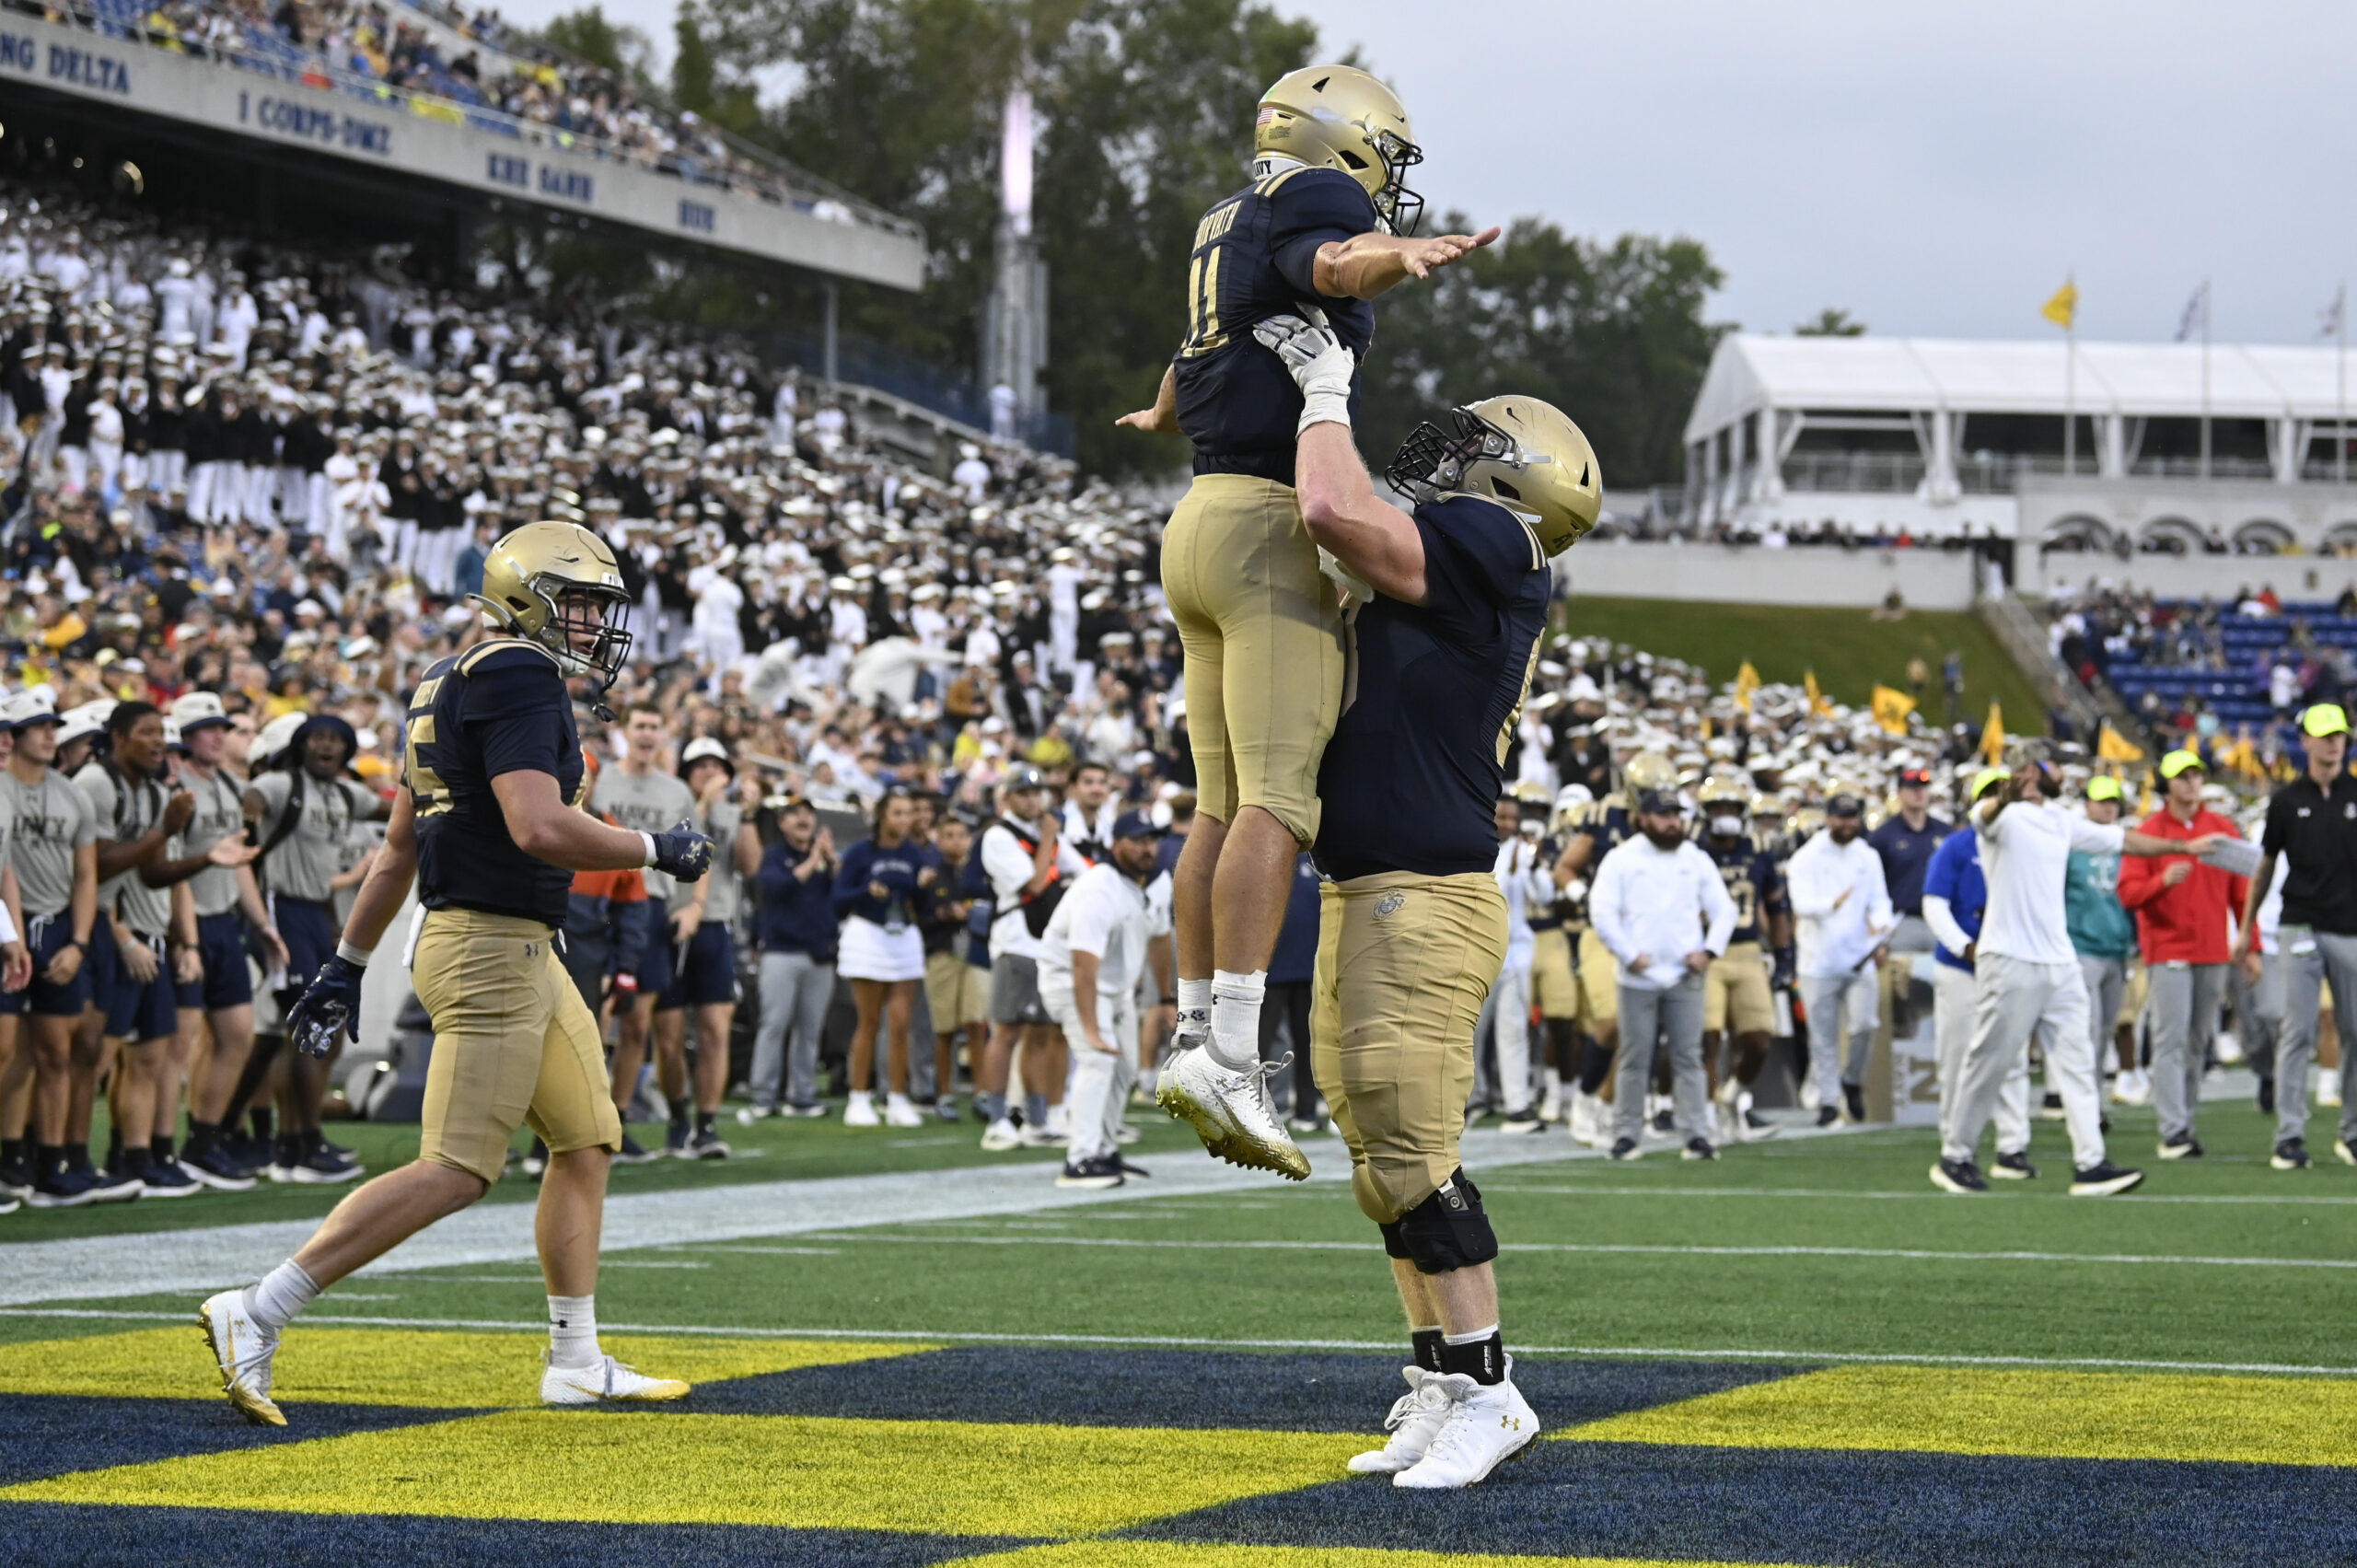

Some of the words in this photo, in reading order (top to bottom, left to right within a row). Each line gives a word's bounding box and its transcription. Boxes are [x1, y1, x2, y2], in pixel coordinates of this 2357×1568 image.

[49, 44, 131, 95] DELTA
[1253, 159, 1271, 176] AVY
[1183, 245, 1230, 357] 11
